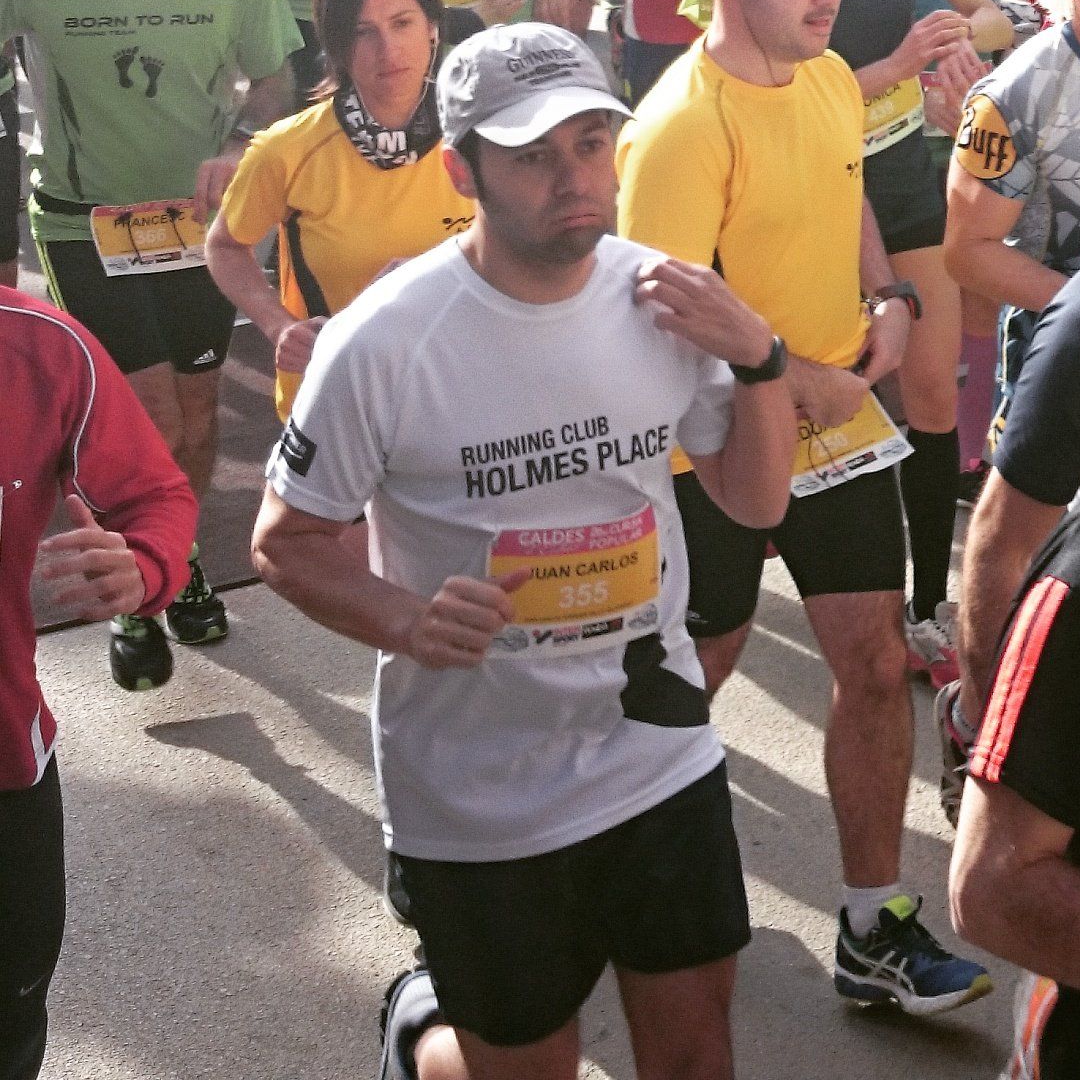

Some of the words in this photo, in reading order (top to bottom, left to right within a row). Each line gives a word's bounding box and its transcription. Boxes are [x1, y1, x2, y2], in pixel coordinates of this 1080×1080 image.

[64, 16, 128, 29] BORN
[136, 15, 164, 26] TO
[170, 13, 214, 26] RUN
[461, 429, 556, 467] RUNNING
[561, 415, 610, 445] CLUB
[466, 447, 590, 499] HOLMES
[597, 424, 670, 471] PLACE
[530, 566, 571, 581] JUAN
[576, 551, 639, 578] CARLOS
[558, 581, 609, 610] 355
